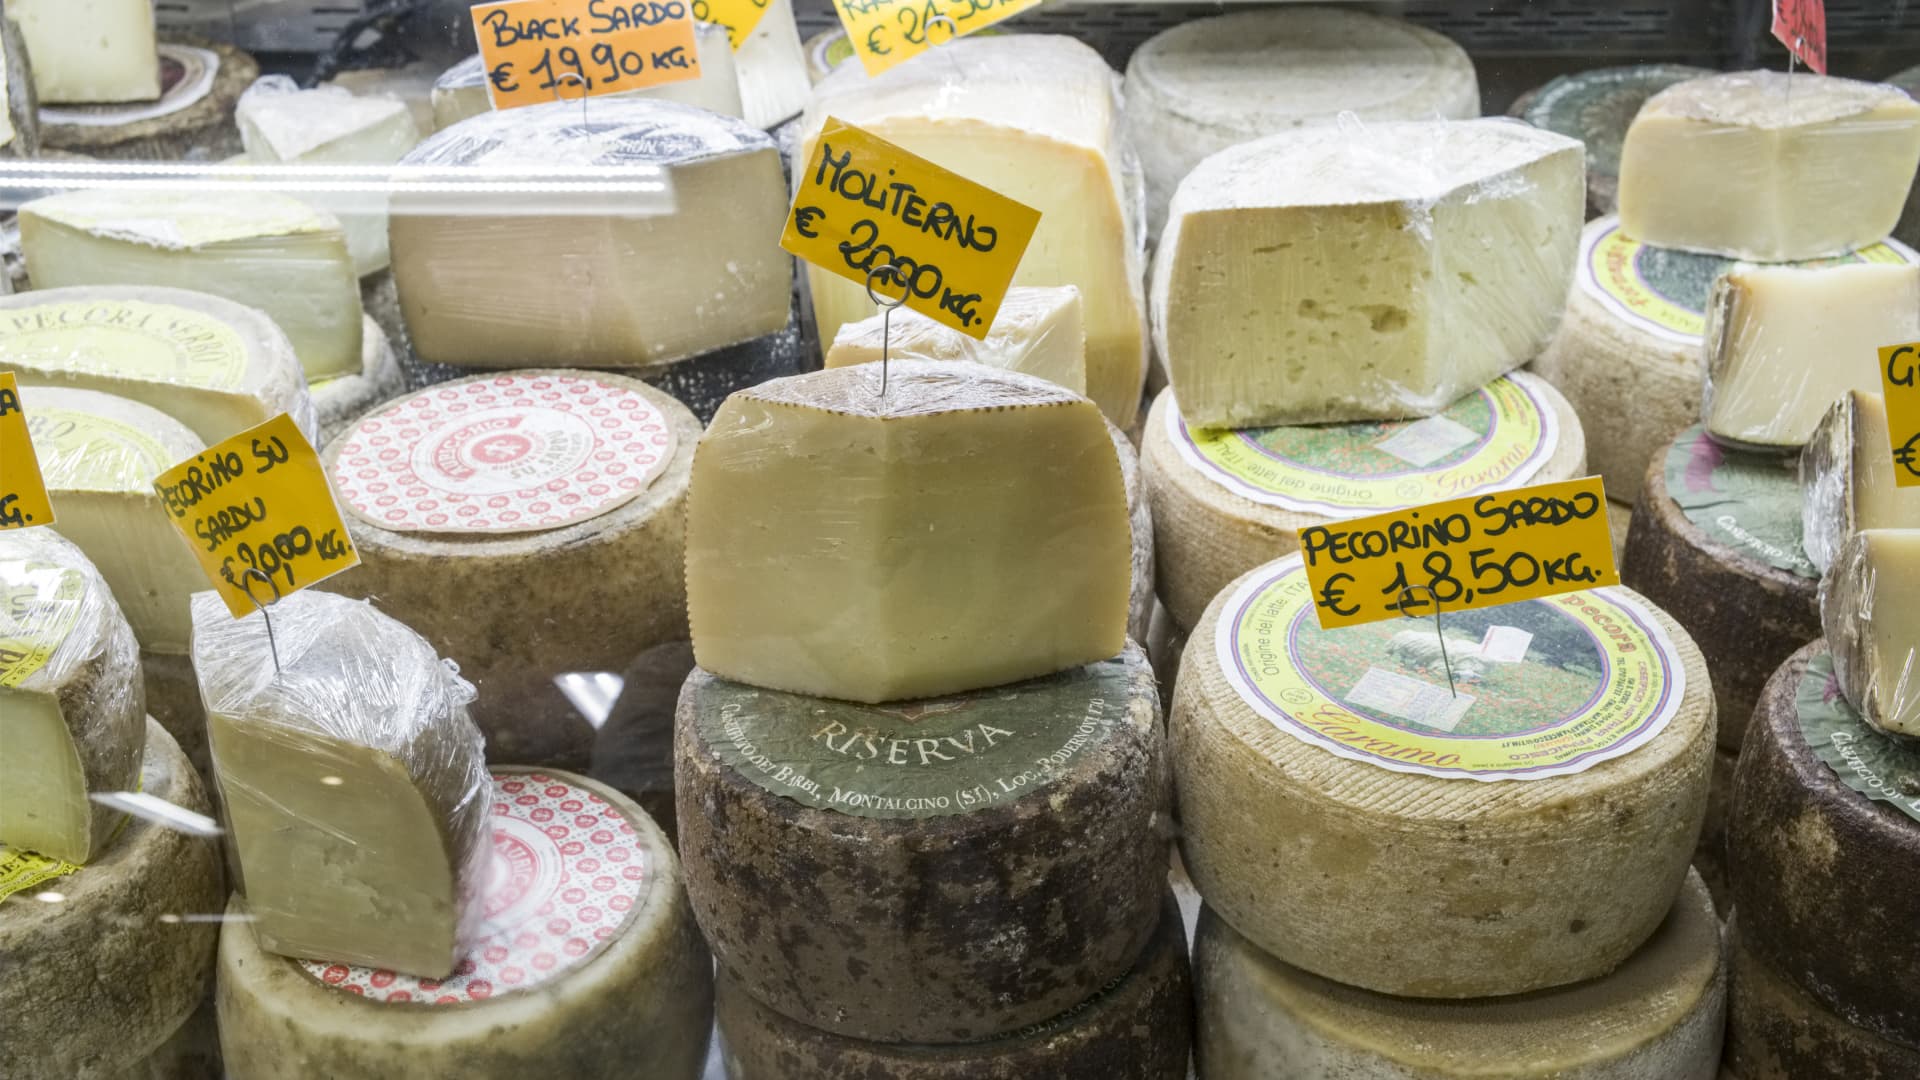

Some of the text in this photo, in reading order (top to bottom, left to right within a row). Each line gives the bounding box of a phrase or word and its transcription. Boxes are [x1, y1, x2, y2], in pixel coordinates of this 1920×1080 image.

[482, 9, 581, 47] BLACK
[589, 0, 685, 33] SARDO
[489, 62, 519, 92] €
[529, 43, 644, 90] 19,90
[795, 206, 826, 238] €
[251, 436, 289, 474] SU
[1302, 492, 1599, 566] PECORINO SARDO
[1319, 572, 1361, 616] €
[1382, 548, 1540, 611] 18,50
[811, 720, 1016, 765] RISERVA
[827, 786, 950, 811] MONTALCINO
